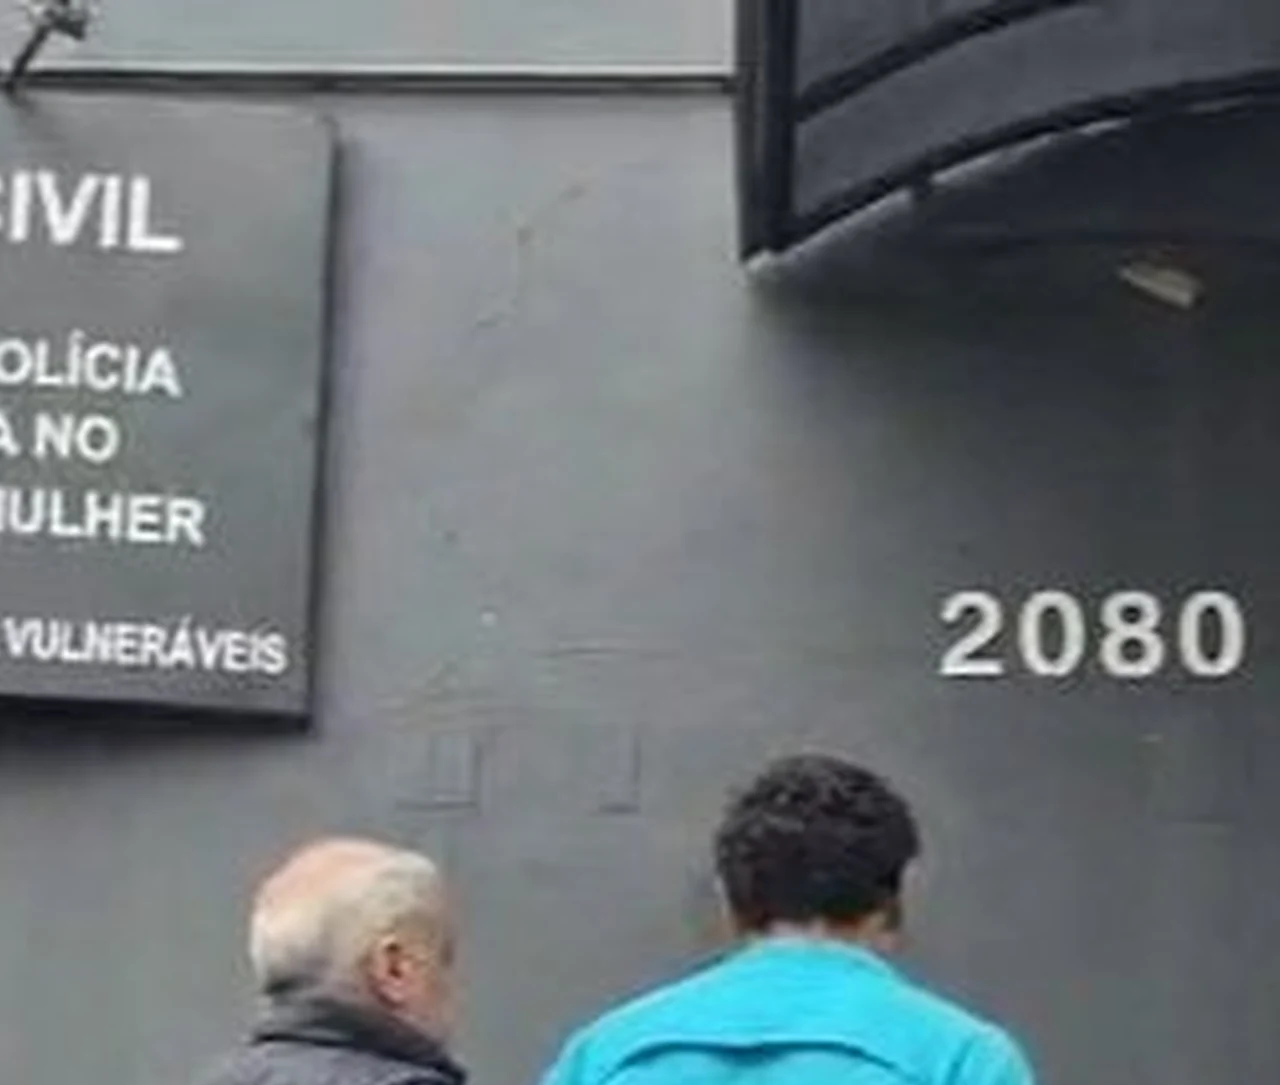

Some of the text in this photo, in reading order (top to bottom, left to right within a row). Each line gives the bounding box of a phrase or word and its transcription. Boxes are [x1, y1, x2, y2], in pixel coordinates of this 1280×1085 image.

[33, 414, 120, 462] NO
[4, 613, 288, 675] VULNERÁVEIS
[939, 589, 1246, 677] 2080
